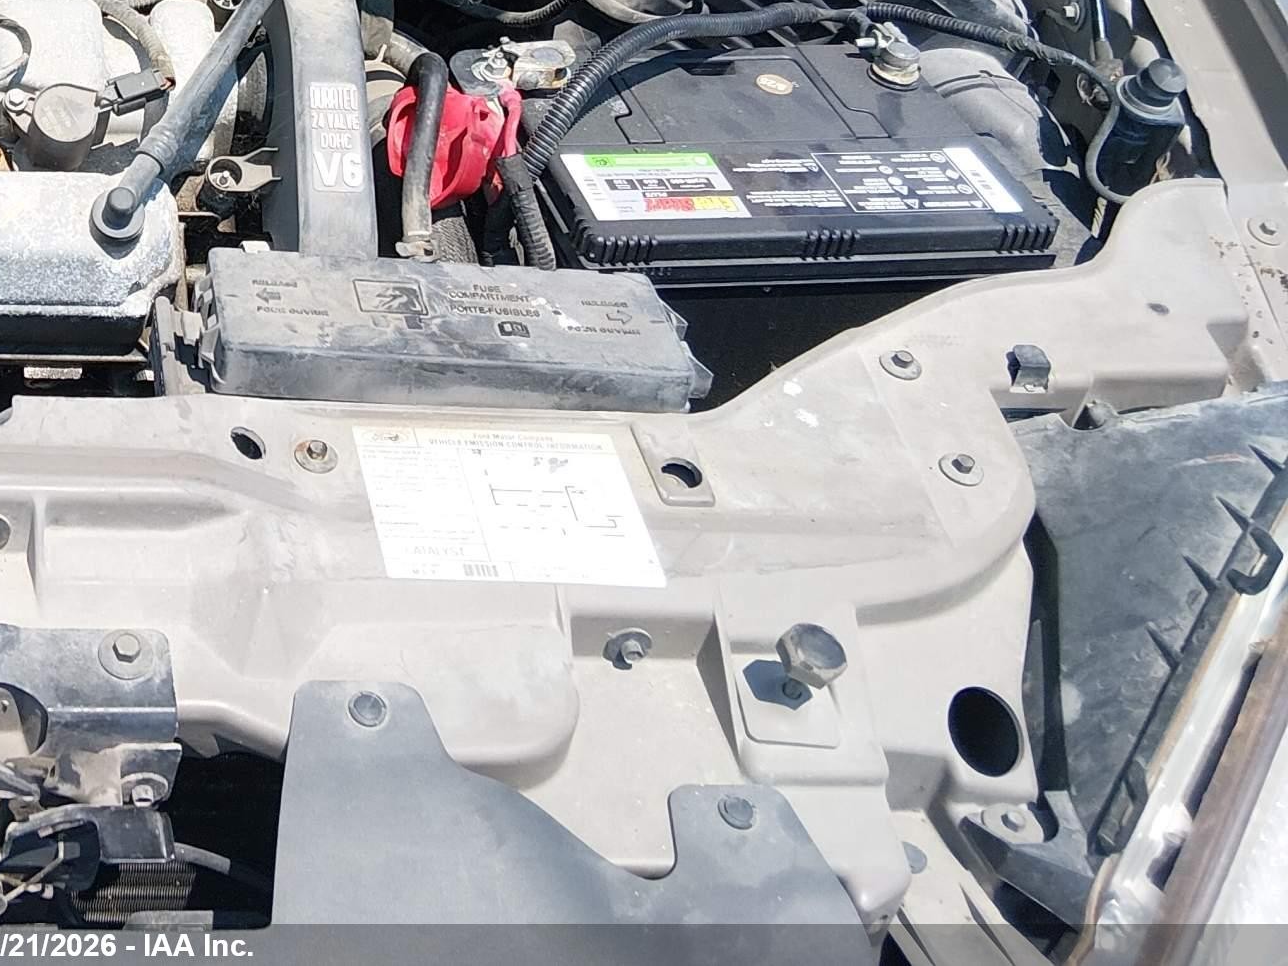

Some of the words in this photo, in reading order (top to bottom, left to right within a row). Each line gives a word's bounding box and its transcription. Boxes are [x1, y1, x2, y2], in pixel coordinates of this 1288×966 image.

[320, 133, 353, 150] DOHC
[313, 152, 364, 188] V6
[473, 284, 501, 293] FUSE
[449, 291, 530, 303] COMPARTMENT
[464, 439, 504, 447] EMISSION
[506, 440, 545, 449] CONTROL
